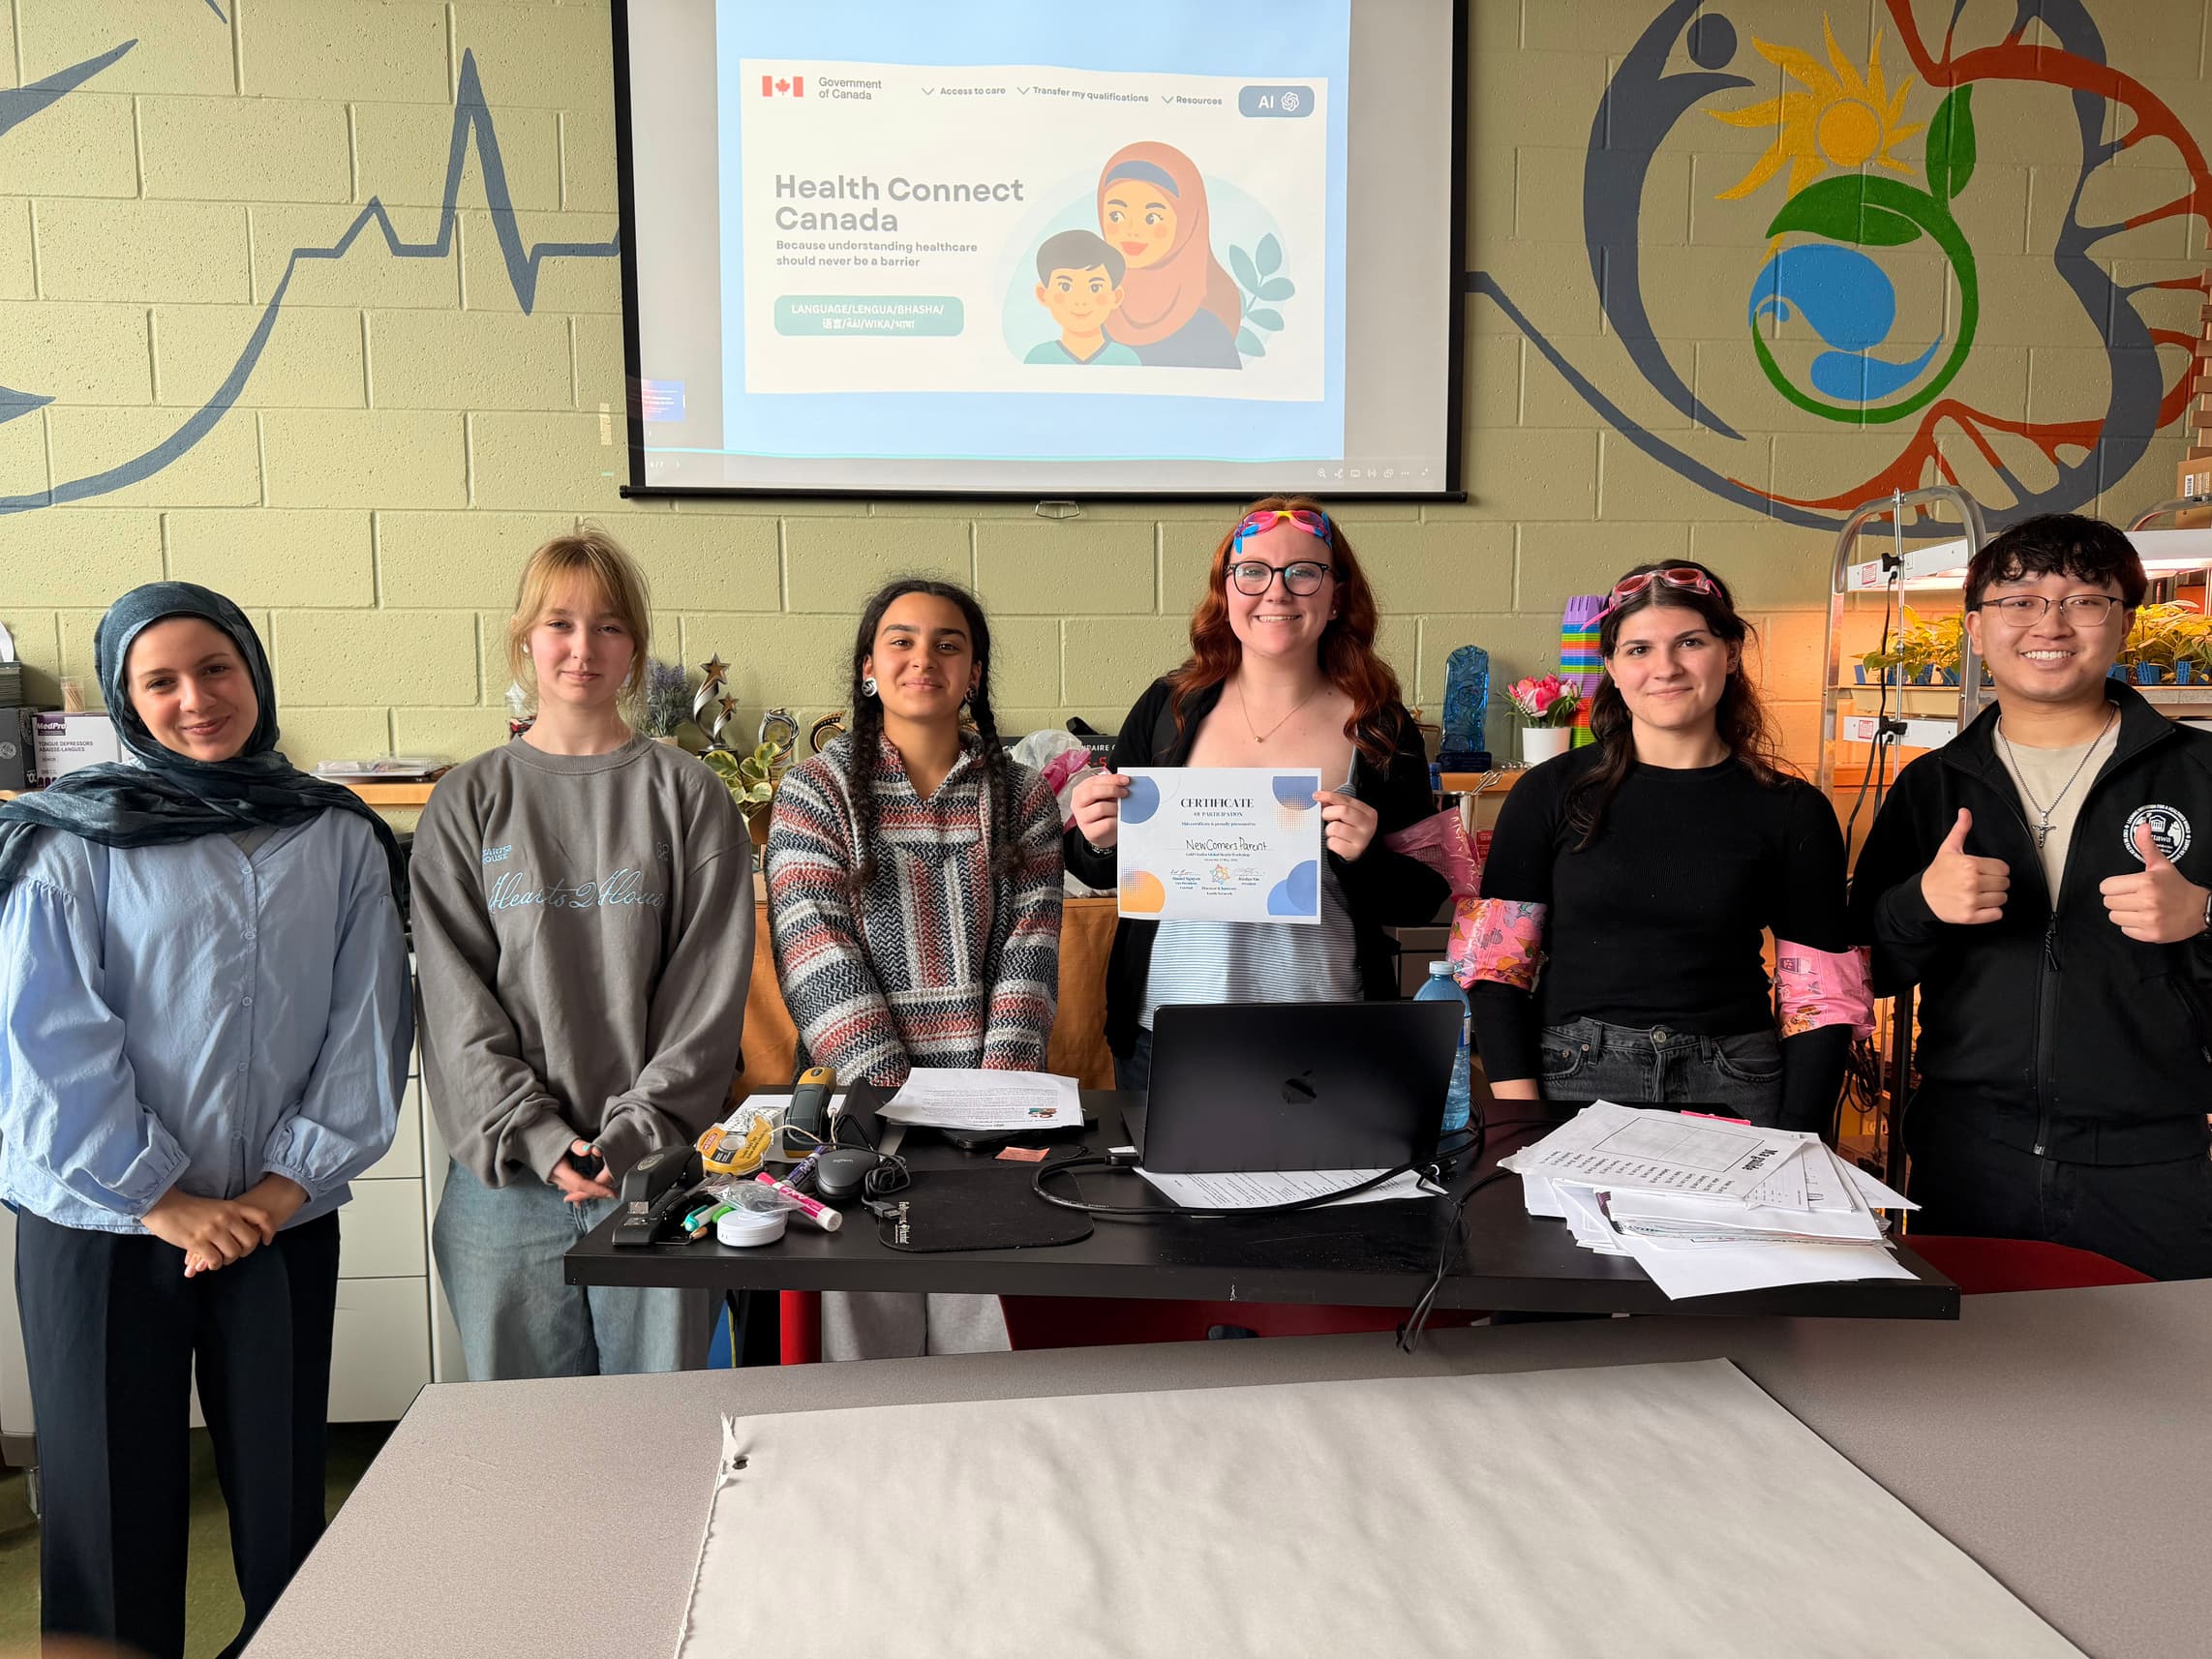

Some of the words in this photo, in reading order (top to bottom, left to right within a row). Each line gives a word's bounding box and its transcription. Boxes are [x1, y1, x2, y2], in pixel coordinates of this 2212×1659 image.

[819, 76, 882, 89] Government
[819, 89, 830, 99] of
[832, 89, 872, 100] Canada
[940, 87, 972, 96] Access
[1033, 86, 1070, 98] Transfer
[1072, 90, 1085, 100] my
[1087, 91, 1149, 103] qualifications
[1176, 96, 1223, 106] Resources
[1258, 96, 1274, 108] AI
[775, 174, 880, 200] Health
[888, 177, 1024, 202] Connect
[774, 206, 898, 232] Canada
[776, 240, 826, 251] Because
[828, 241, 913, 254] understanding
[915, 241, 978, 253] healthcare
[776, 256, 815, 266] should
[819, 257, 851, 266] never
[854, 256, 868, 266] be
[880, 256, 921, 267] barrier
[791, 304, 945, 315] LANGUAGE/LENGUA/BHASHA/
[1180, 799, 1254, 808] CERTIFICATE
[1238, 836, 1268, 852] Parent
